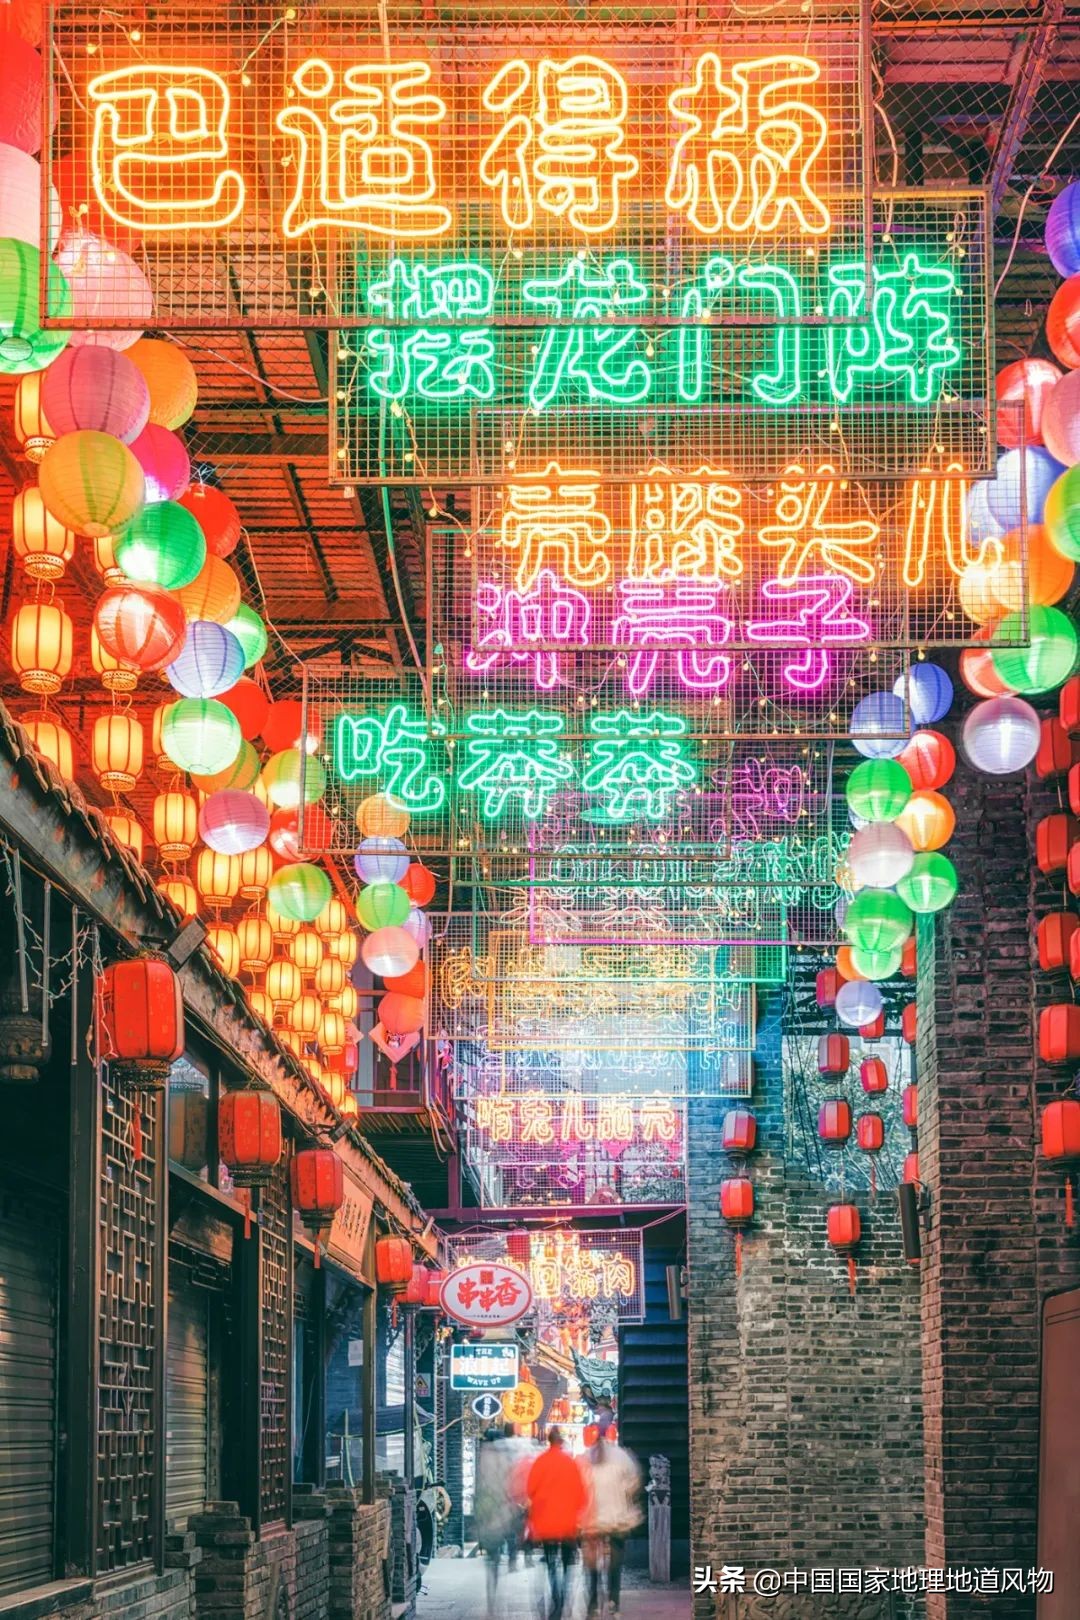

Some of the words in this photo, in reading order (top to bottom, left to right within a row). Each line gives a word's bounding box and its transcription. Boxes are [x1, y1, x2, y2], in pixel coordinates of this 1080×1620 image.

[87, 53, 832, 239] 巴适得板
[367, 254, 960, 410] 摆龙门阵
[466, 567, 870, 694] 冲壳子
[457, 1252, 636, 1299] 回锅肉
[457, 1276, 522, 1313] 串串香
[467, 1376, 489, 1386] WAVE
